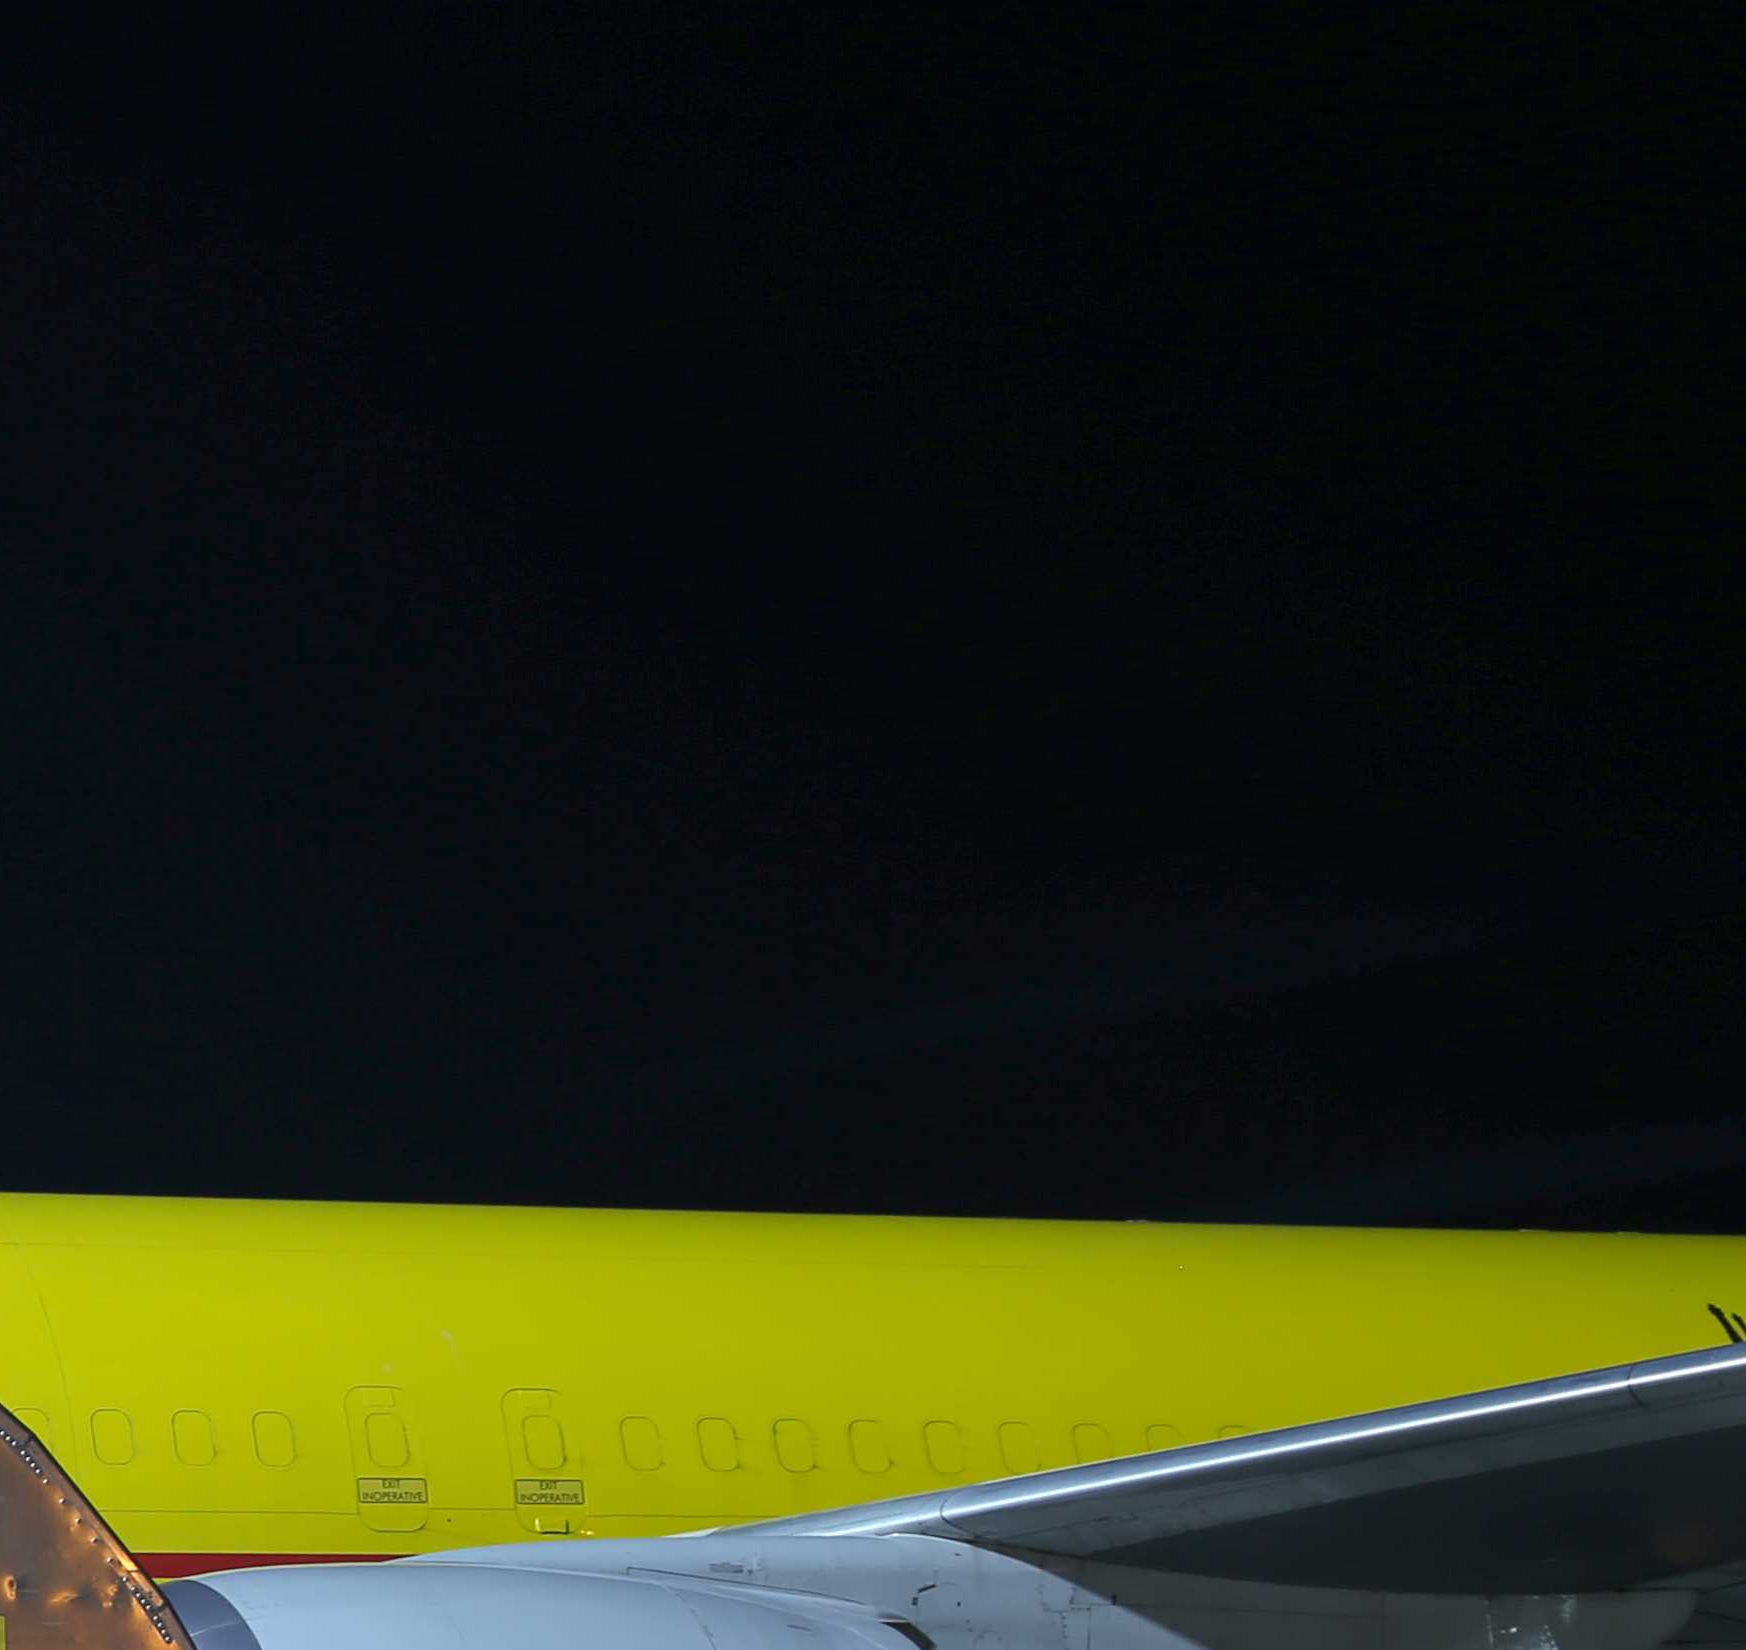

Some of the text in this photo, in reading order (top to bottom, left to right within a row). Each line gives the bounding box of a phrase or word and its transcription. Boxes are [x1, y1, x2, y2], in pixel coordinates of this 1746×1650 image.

[382, 1479, 400, 1489] EXIT
[539, 1480, 557, 1490] EXIT
[363, 1491, 423, 1501] INOPERATIVE
[520, 1492, 580, 1502] INOPERATIVE
